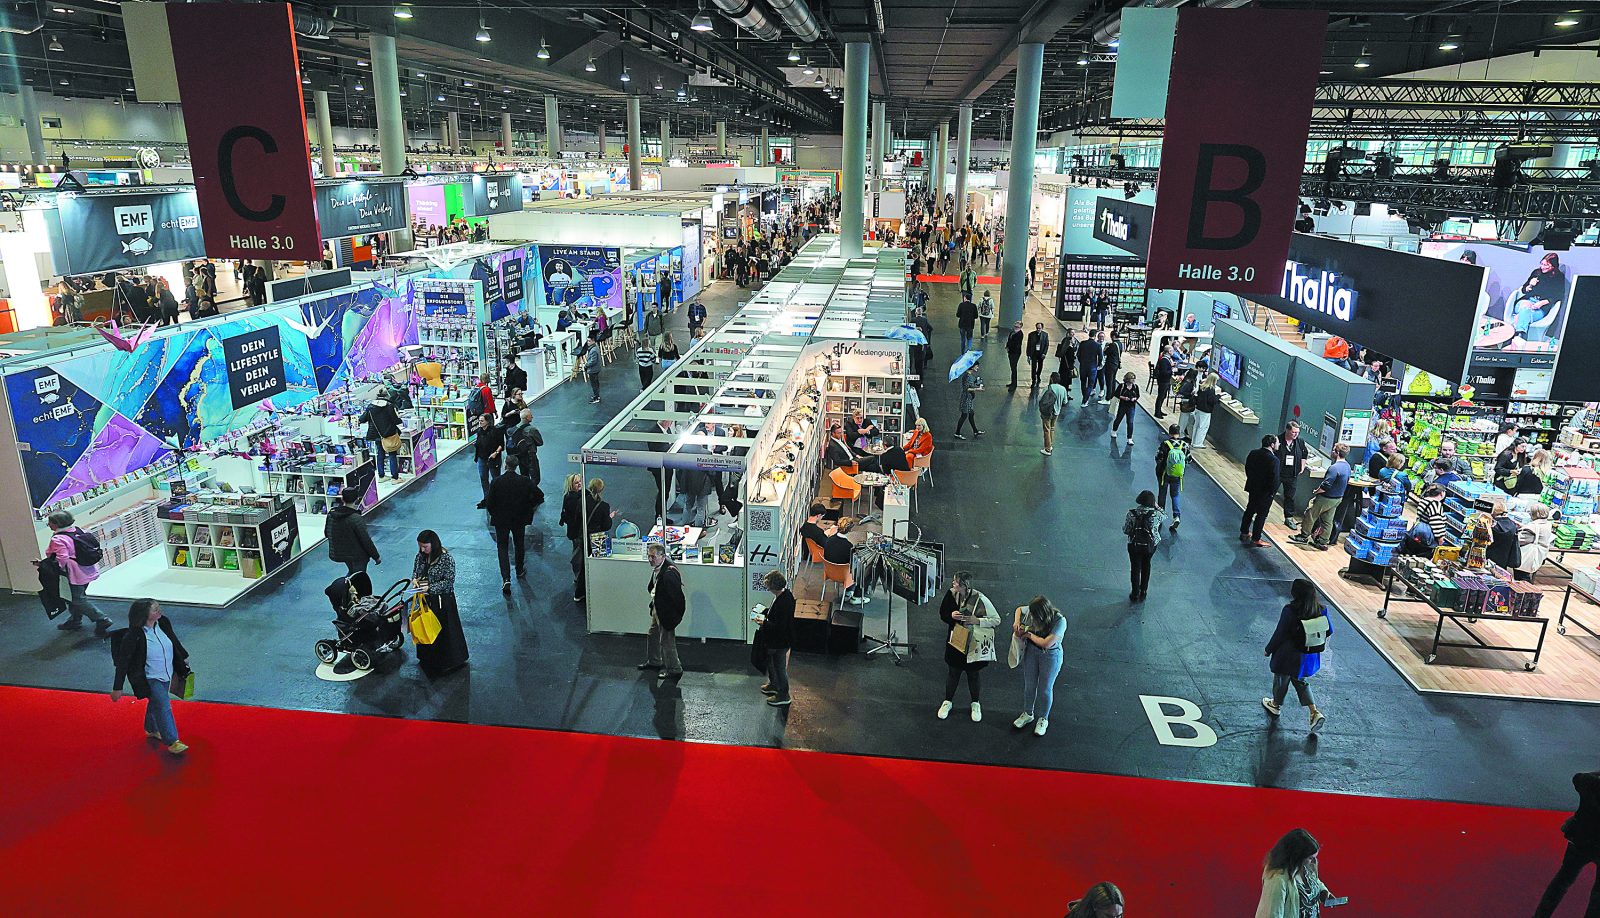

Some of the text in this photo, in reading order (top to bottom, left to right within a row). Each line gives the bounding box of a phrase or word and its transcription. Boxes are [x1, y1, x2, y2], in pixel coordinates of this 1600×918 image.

[217, 125, 286, 222] C
[331, 198, 345, 208] Dein
[347, 190, 372, 207] Lifestyle
[1186, 143, 1266, 251] B
[374, 202, 392, 217] Verlag
[120, 212, 148, 227] EMF
[1106, 212, 1128, 241] Thalia
[230, 235, 294, 251] Halle 3.0
[1178, 264, 1255, 282] Halle 3.0
[1280, 260, 1352, 322] Thalia
[241, 339, 265, 354] DEIN
[231, 349, 279, 372] LIFESTYLE
[245, 366, 269, 382] DEIN
[1475, 375, 1496, 385] Thalia
[38, 379, 57, 390] EMF
[240, 377, 277, 397] VERLAG
[274, 526, 287, 540] EMF
[1139, 694, 1218, 748] B
